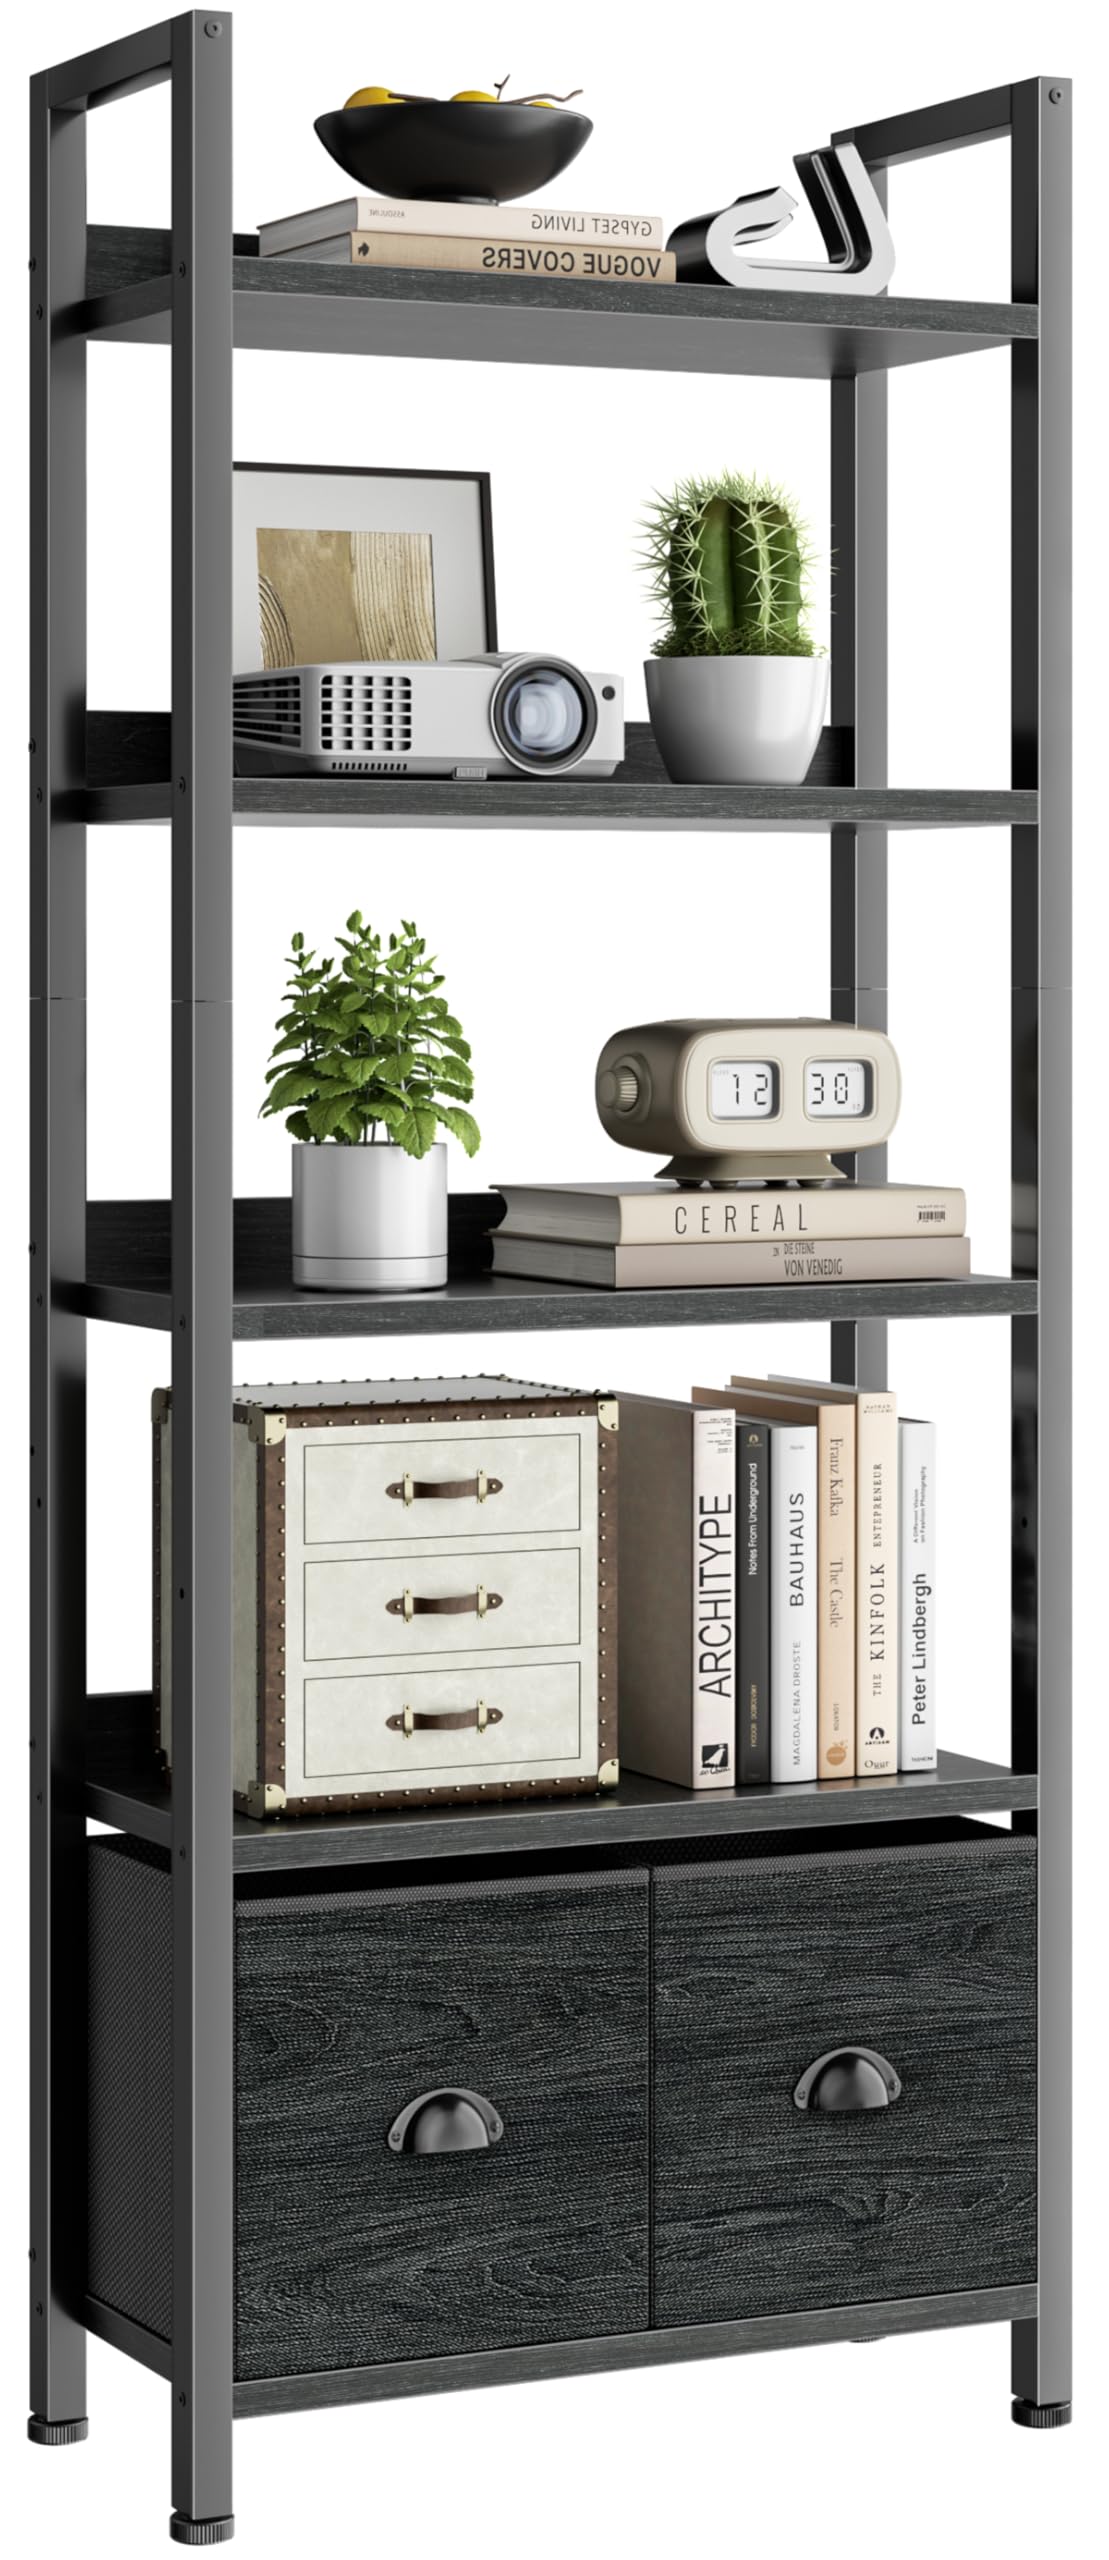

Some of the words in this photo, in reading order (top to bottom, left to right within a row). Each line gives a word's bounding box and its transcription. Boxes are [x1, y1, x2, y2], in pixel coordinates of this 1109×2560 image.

[732, 1073, 769, 1106] 12
[811, 1072, 849, 1105] 30
[674, 1202, 809, 1236] CEREAL
[784, 1242, 794, 1256] DIE
[795, 1242, 815, 1255] STEINE
[784, 1258, 804, 1278] VON
[806, 1257, 843, 1277] VENEDIG
[829, 1438, 845, 1475] Franz
[748, 1462, 760, 1523] Underground
[829, 1478, 845, 1517] Kafka
[872, 1463, 884, 1549] ENTEPRENEUR
[919, 1466, 928, 1507] Photography
[748, 1524, 759, 1548] From
[788, 1492, 806, 1608] BAUHAUS
[920, 1534, 926, 1544] on
[748, 1548, 759, 1576] Notes
[829, 1557, 845, 1585] The
[698, 1493, 733, 1699] ARCHITYPE
[829, 1588, 845, 1629] Castle
[869, 1563, 886, 1662] KINFOLK
[911, 1572, 933, 1671] Lindbergh
[792, 1641, 802, 1687] DROSTE
[872, 1673, 883, 1698] THE
[911, 1674, 927, 1726] Peter
[792, 1688, 802, 1767] MAGDALENA
